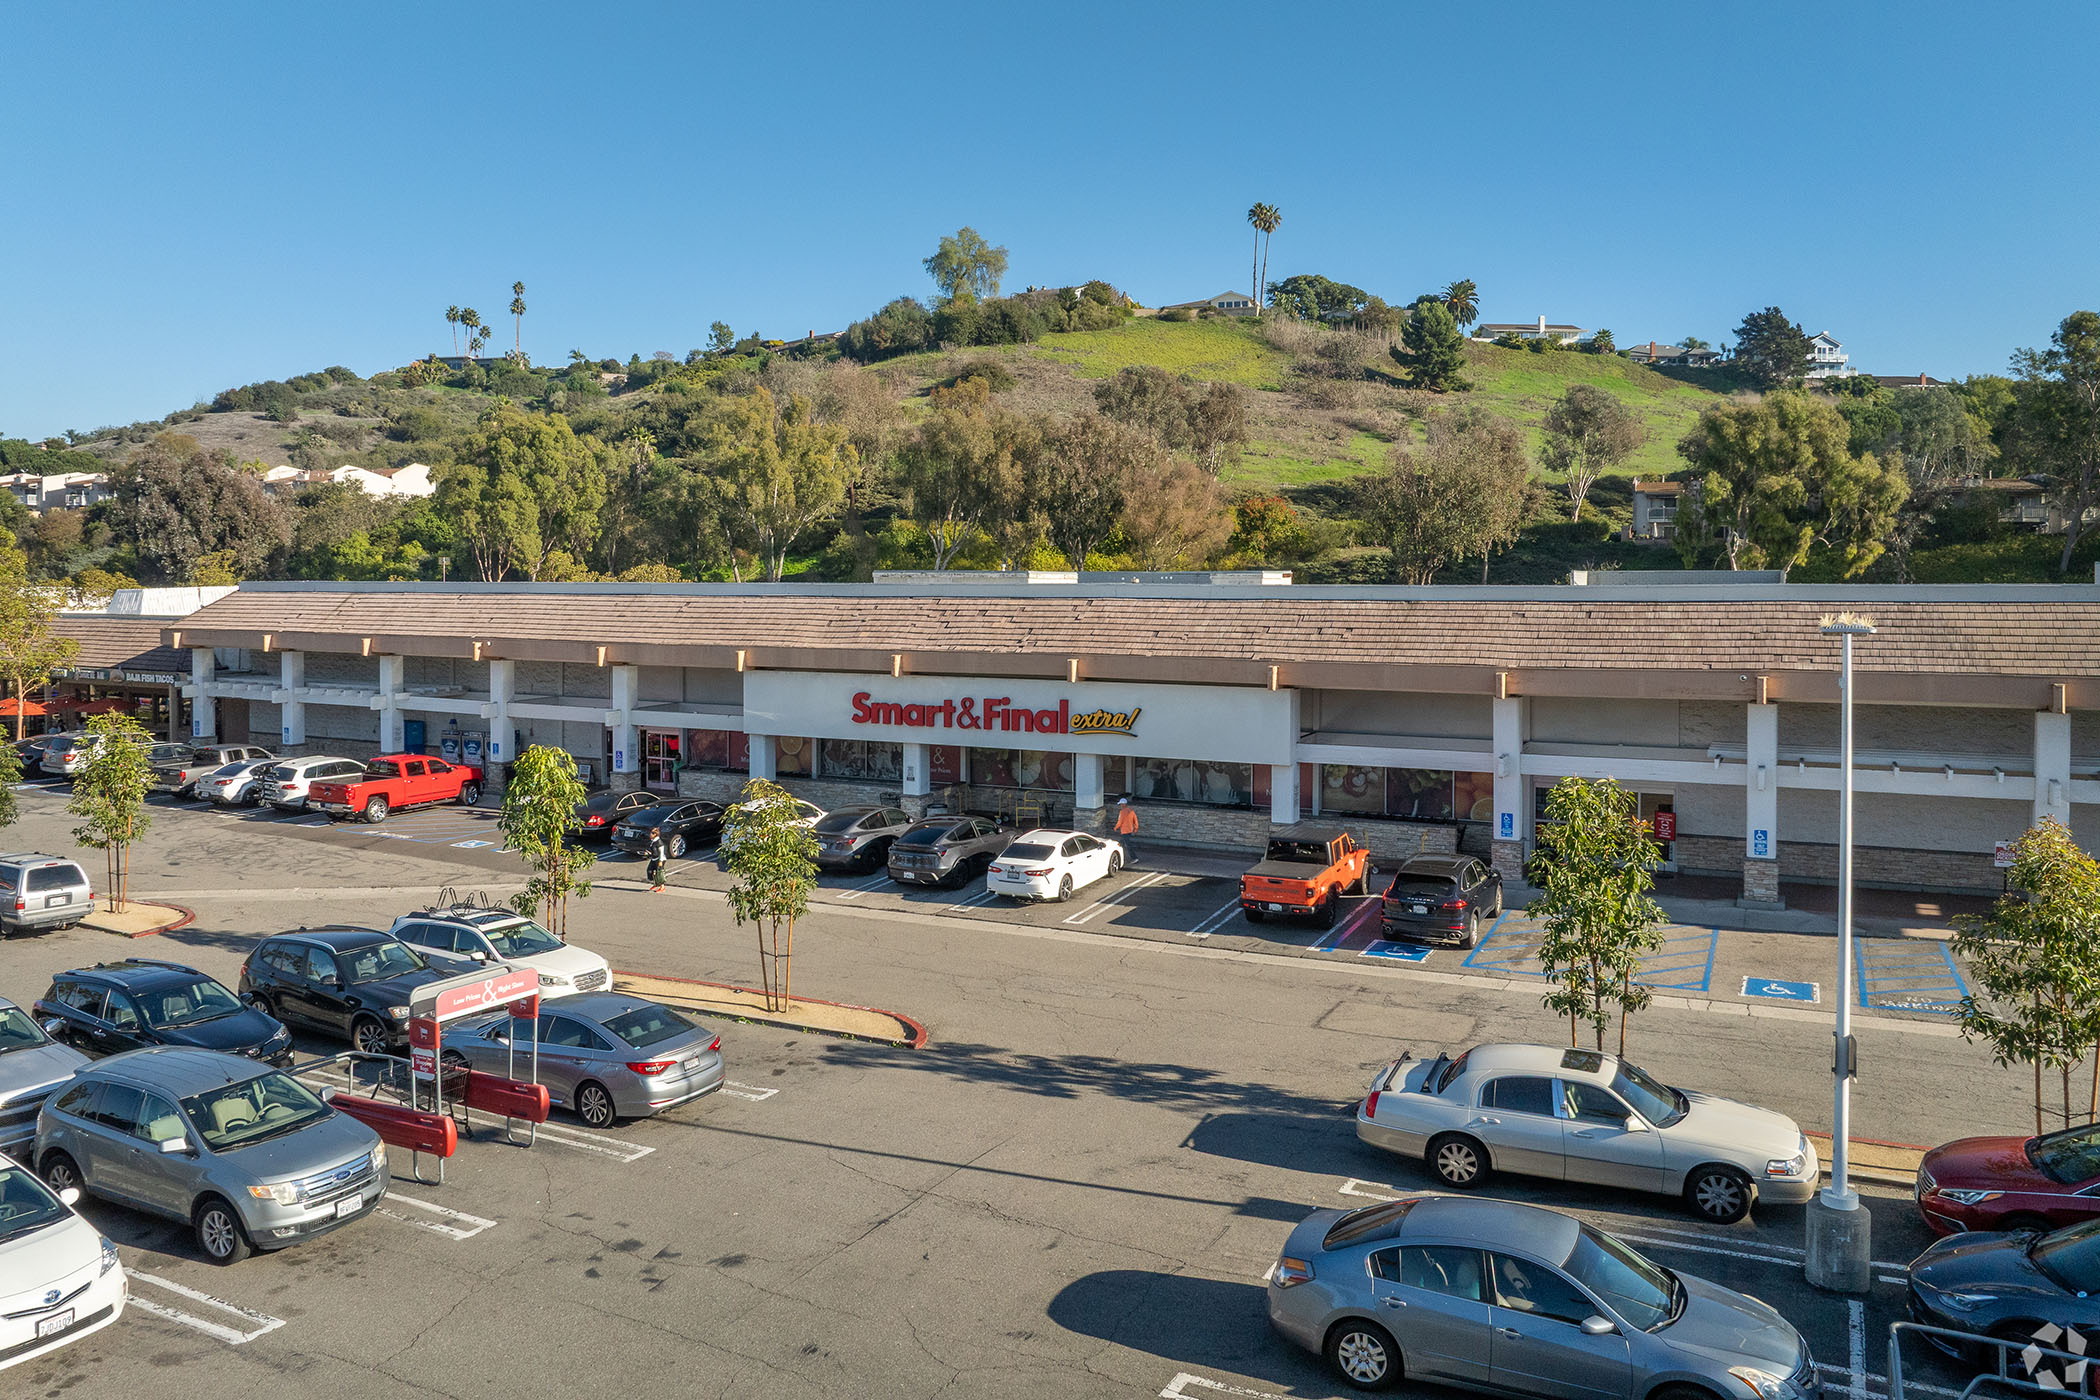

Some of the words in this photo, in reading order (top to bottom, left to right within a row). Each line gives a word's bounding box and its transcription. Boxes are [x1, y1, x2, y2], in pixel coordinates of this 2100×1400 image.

[126, 673, 140, 681] BAJA
[141, 674, 155, 682] FISH
[155, 675, 174, 683] TACOS
[1070, 707, 1142, 734] extra!
[481, 979, 498, 1004] &
